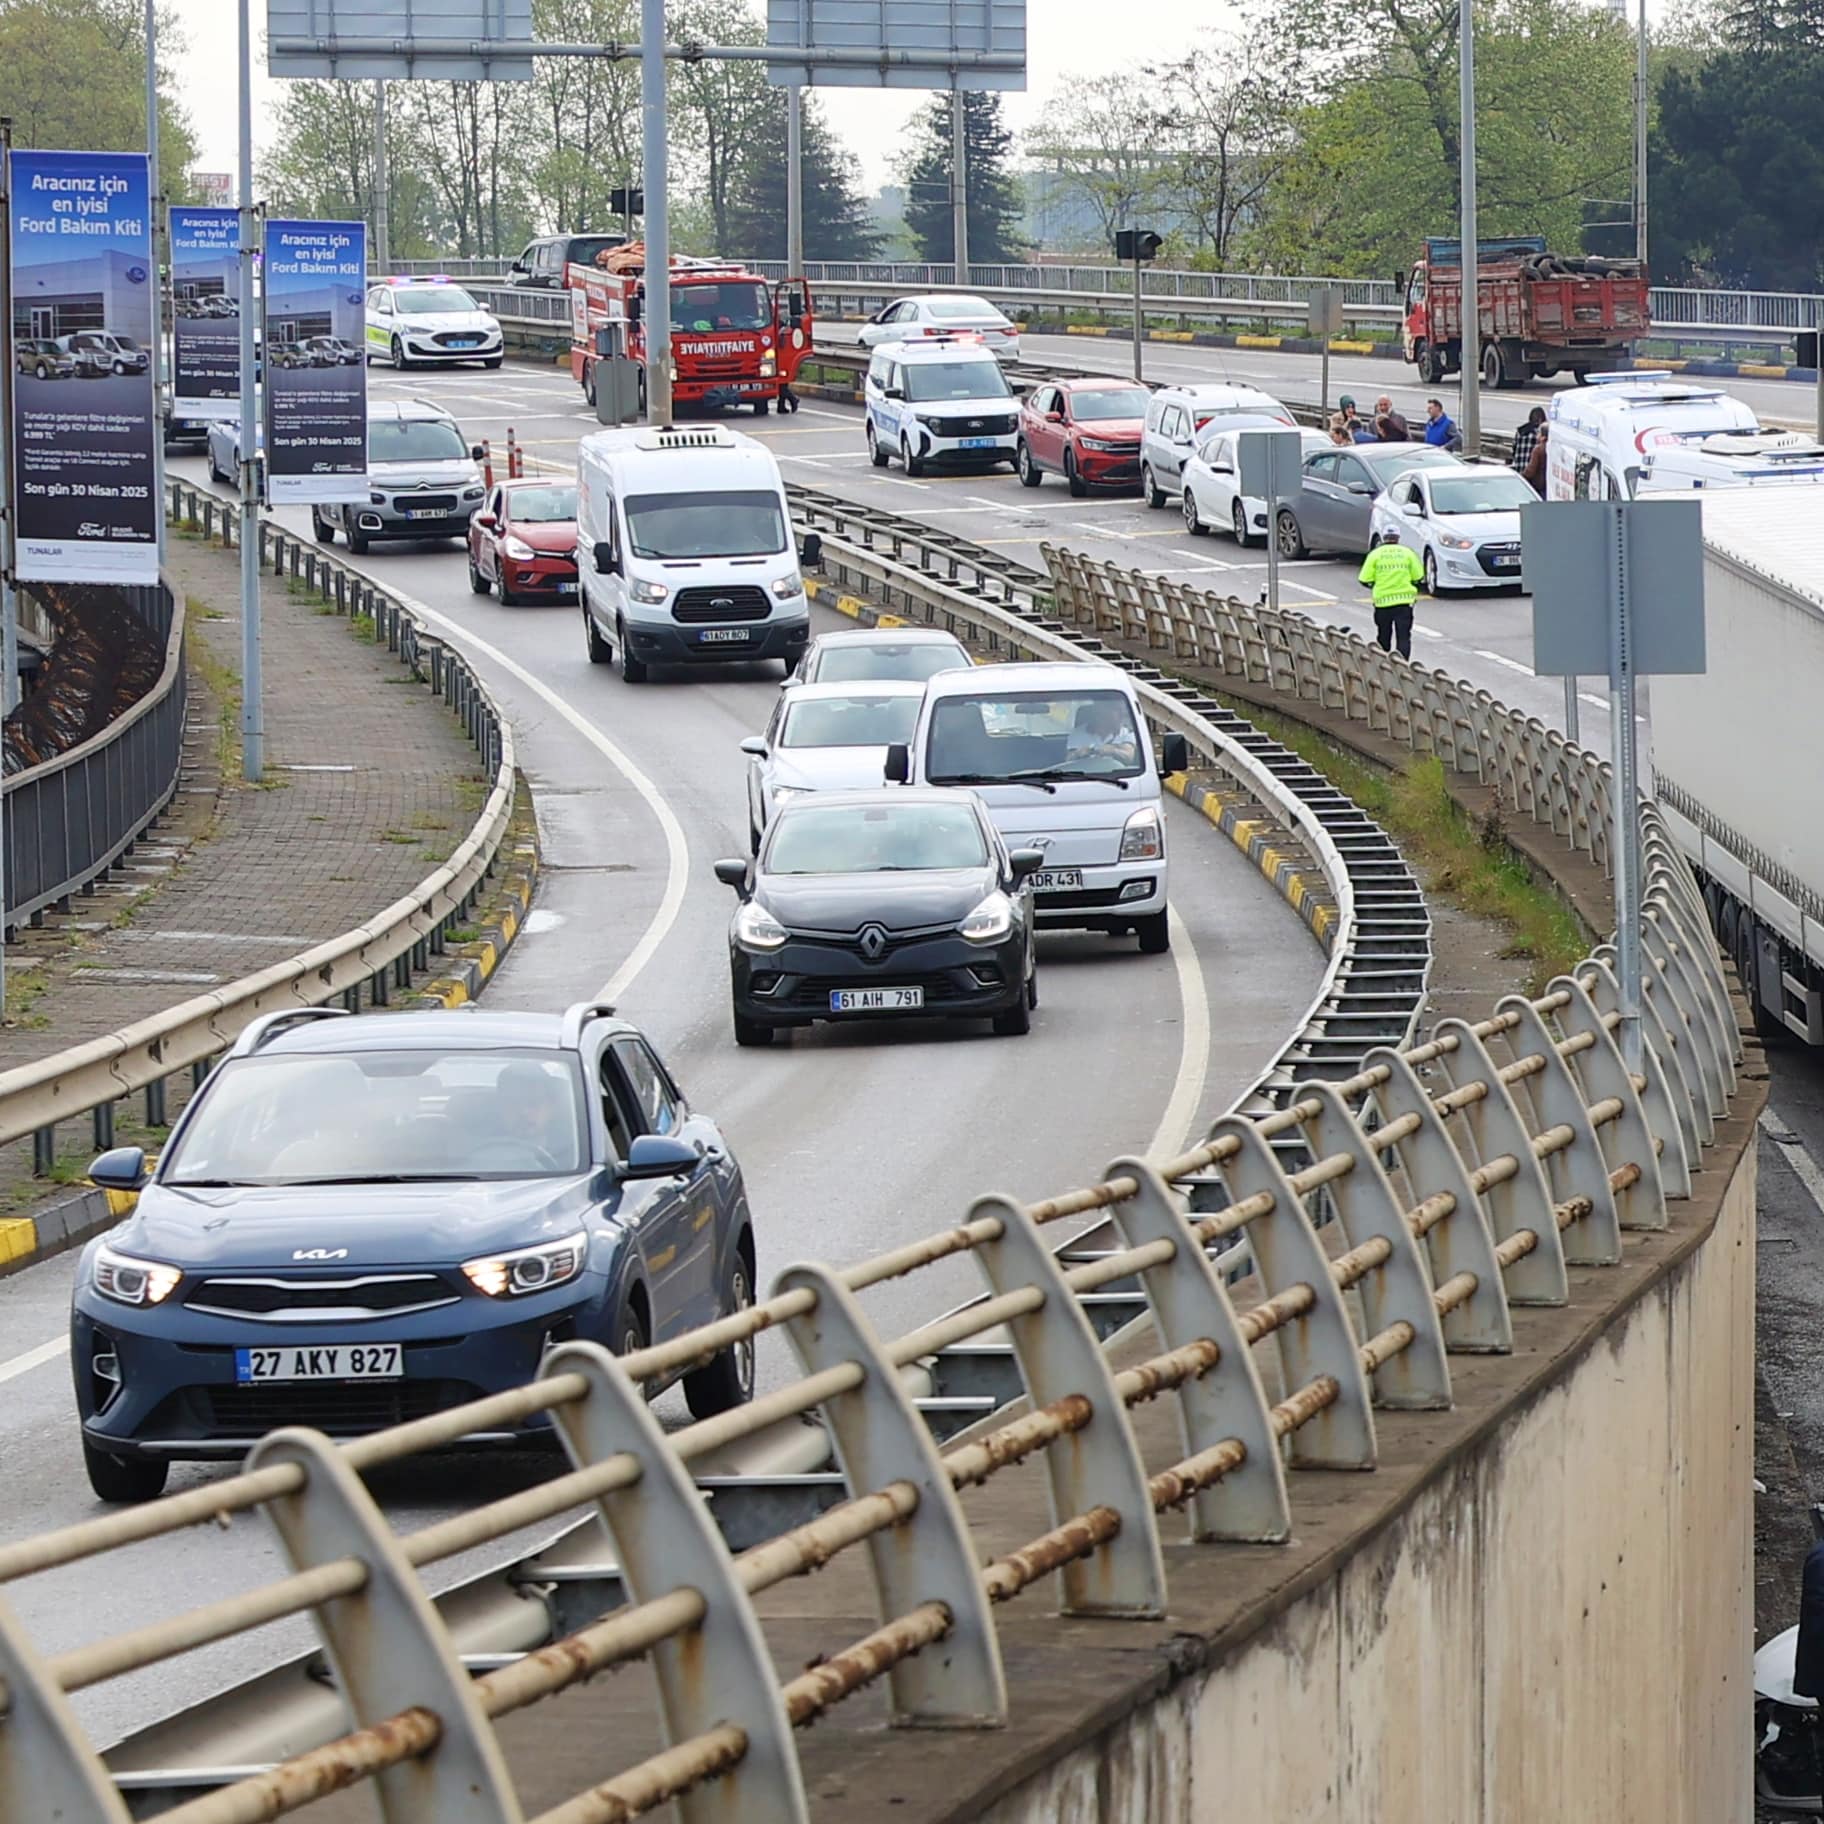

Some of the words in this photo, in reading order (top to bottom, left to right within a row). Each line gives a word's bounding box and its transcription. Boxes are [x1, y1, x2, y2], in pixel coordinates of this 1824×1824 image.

[32, 174, 96, 191] Aracınız
[100, 176, 128, 196] için
[52, 199, 72, 212] en
[77, 196, 108, 216] iyisi
[20, 217, 56, 233] Ford
[61, 218, 110, 235] Bakım
[115, 219, 142, 236] Kiti
[194, 230, 207, 238] en
[176, 239, 197, 248] Ford
[280, 234, 327, 246] Aracınız
[329, 235, 350, 249] için
[295, 250, 309, 260] en
[312, 248, 336, 261] iyisi
[271, 262, 298, 273] Ford
[301, 262, 337, 274] Bakım
[340, 263, 360, 275] Kiti
[24, 482, 45, 495] Son
[48, 483, 70, 497] gün
[72, 484, 86, 496] 30
[88, 484, 119, 497] Nisan
[121, 486, 148, 498] 2025
[77, 522, 106, 537] Ford
[840, 993, 856, 1008] 61
[862, 993, 884, 1007] AIH
[895, 991, 919, 1006] 791
[252, 1351, 281, 1377] 27
[294, 1349, 339, 1375] AKY
[350, 1347, 398, 1374] 827
